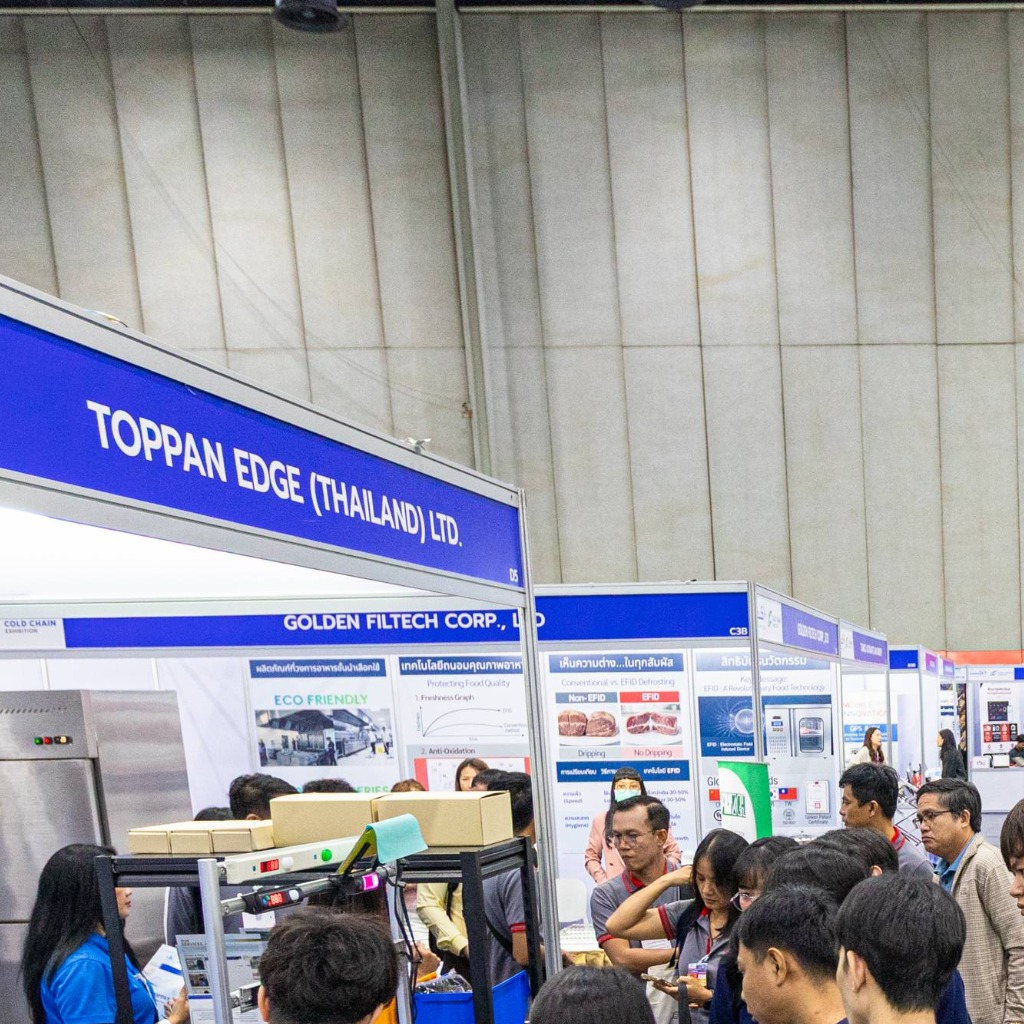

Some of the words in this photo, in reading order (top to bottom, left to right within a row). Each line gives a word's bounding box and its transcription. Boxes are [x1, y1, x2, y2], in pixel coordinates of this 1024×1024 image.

[87, 400, 227, 482] TOPPAN
[235, 448, 304, 503] EDGE
[309, 471, 426, 544] (THAILAND)
[430, 512, 462, 546] LTD.
[509, 568, 519, 584] D5
[4, 620, 28, 628] COLD
[29, 619, 57, 627] CHAIN
[283, 613, 360, 631] GOLDEN
[366, 612, 439, 630] FILTECH
[444, 612, 506, 631] CORP.,
[512, 611, 546, 628] LD
[729, 627, 748, 636] C3B
[427, 680, 464, 689] Protecting
[465, 679, 484, 687] Food
[485, 679, 510, 688] Quality
[561, 678, 608, 687] Conventional
[620, 677, 637, 686] EFID
[638, 677, 675, 687] Defrosting
[790, 684, 825, 692] Technology
[274, 695, 304, 705] ECO
[307, 694, 368, 705] FRIENDLY
[454, 694, 475, 702] Graph
[642, 693, 660, 701] EFID
[578, 750, 606, 758] Dripping
[645, 749, 673, 758] Dripping
